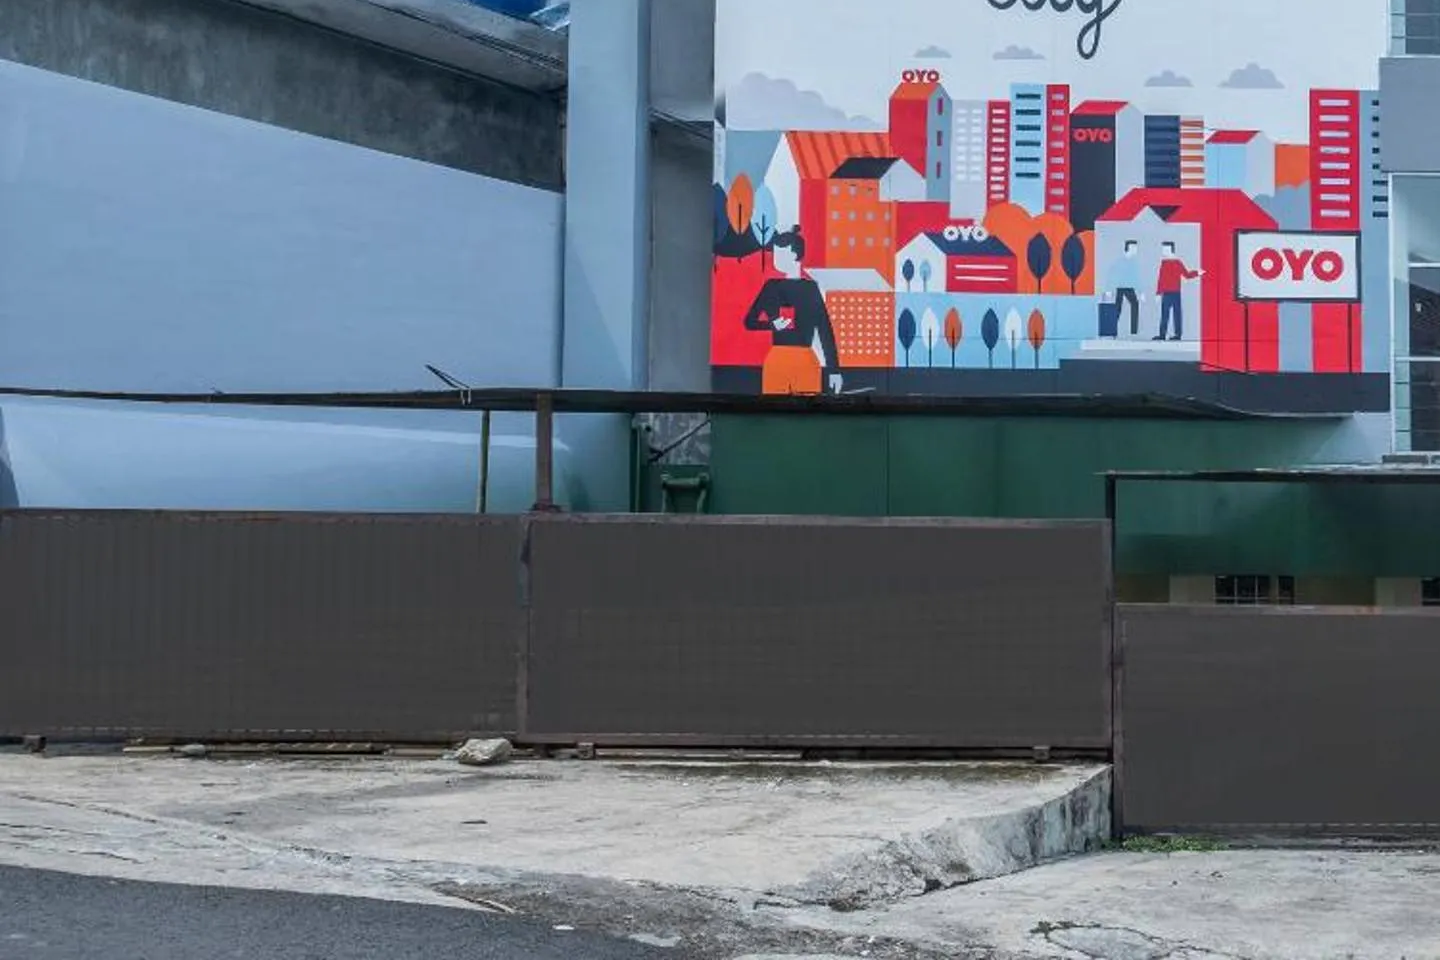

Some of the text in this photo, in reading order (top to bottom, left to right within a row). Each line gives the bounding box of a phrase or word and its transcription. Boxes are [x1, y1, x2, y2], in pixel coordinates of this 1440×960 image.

[901, 69, 940, 83] OYO
[1073, 127, 1113, 143] OYO
[943, 225, 988, 241] OYO
[1250, 247, 1344, 283] OYO
